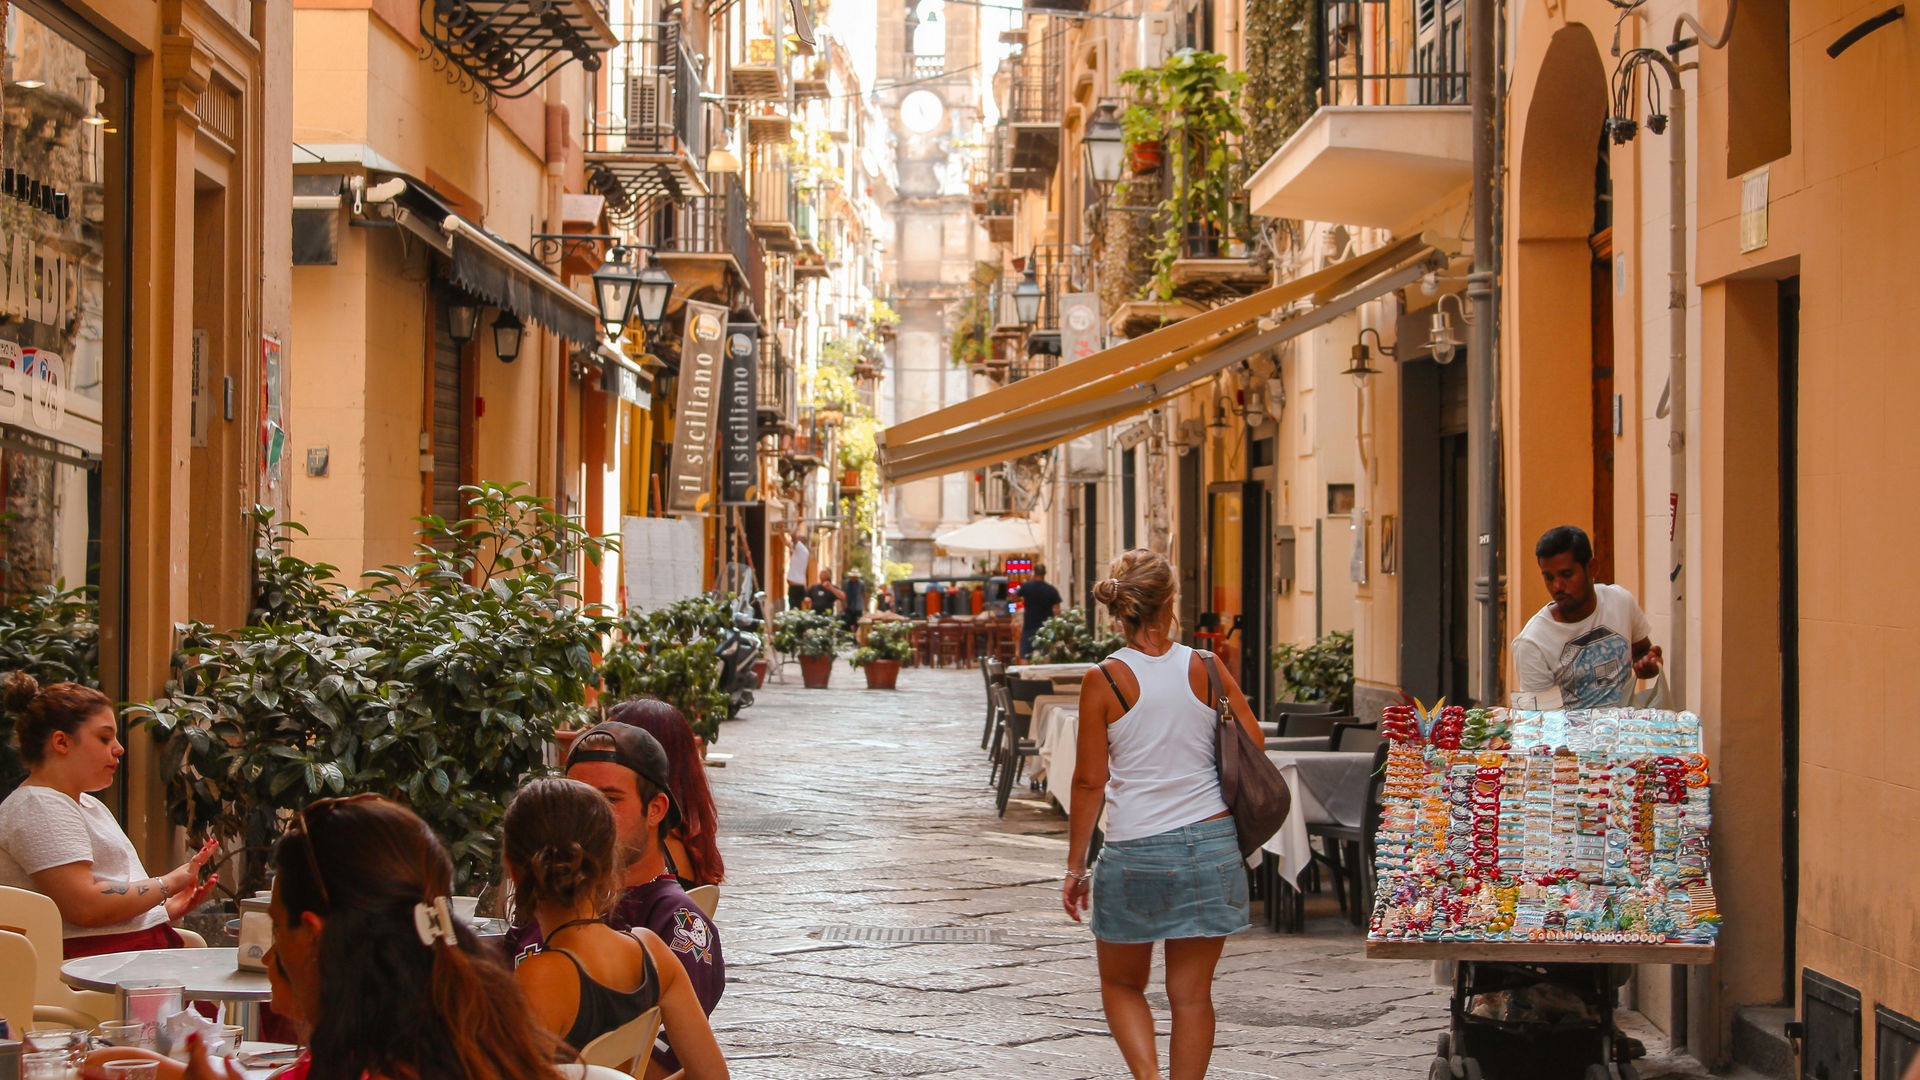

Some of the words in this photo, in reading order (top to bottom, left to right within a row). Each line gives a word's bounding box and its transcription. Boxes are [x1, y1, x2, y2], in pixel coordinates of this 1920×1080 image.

[683, 353, 713, 465] siciliano
[729, 367, 749, 462] siciliano
[678, 474, 702, 492] il
[729, 471, 749, 485] il
